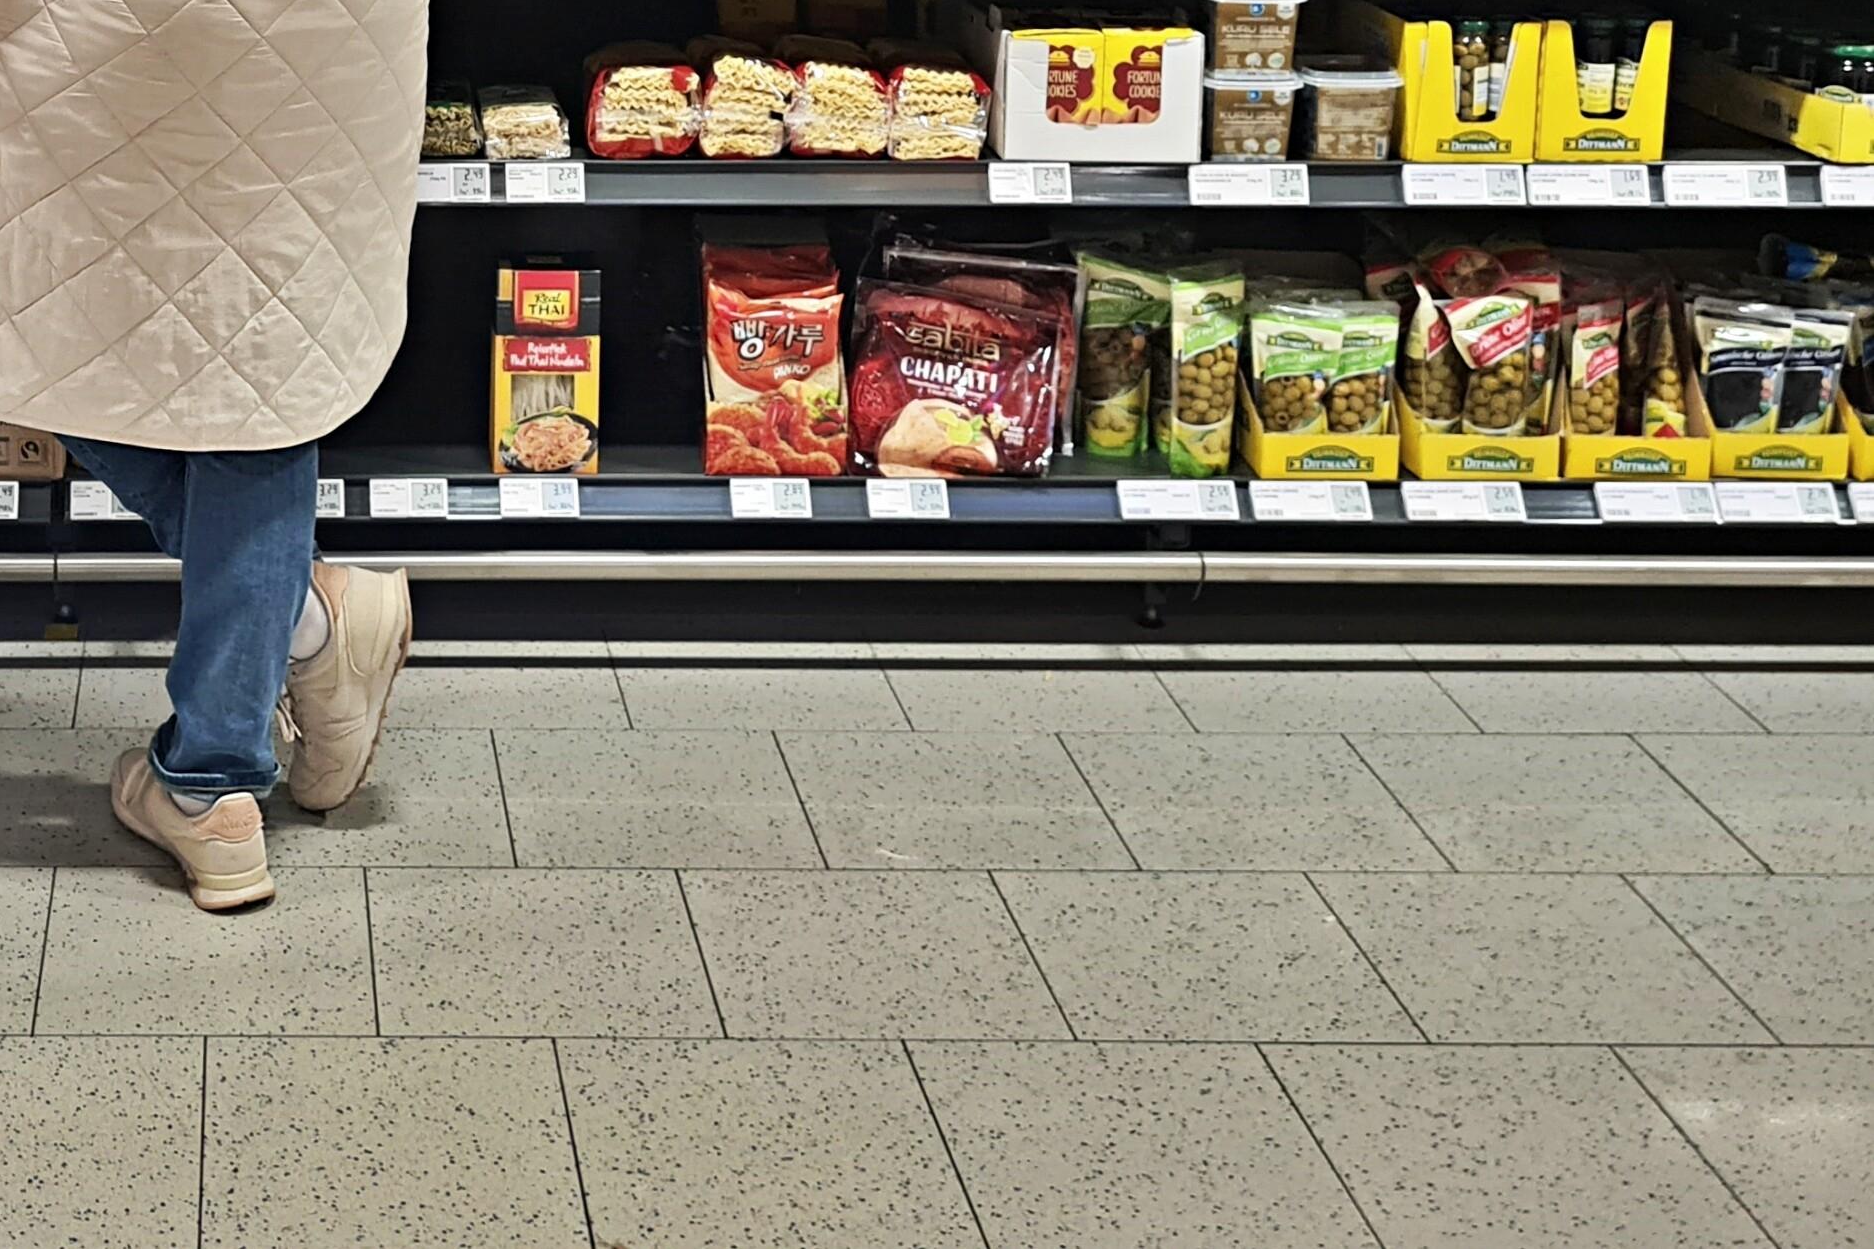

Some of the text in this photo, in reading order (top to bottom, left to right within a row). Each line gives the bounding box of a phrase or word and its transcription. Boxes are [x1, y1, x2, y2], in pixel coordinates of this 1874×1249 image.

[1451, 141, 1498, 152] DITTMANN
[1578, 139, 1626, 151] DITTMANN
[528, 304, 565, 316] THAI
[732, 319, 825, 359] 빵가루
[900, 356, 998, 393] CHAPATI
[1303, 458, 1358, 470] DITTMANN
[1463, 458, 1519, 470] DITTMANN
[1612, 459, 1669, 474] DITTMANN
[1751, 456, 1805, 470] DITTMANN
